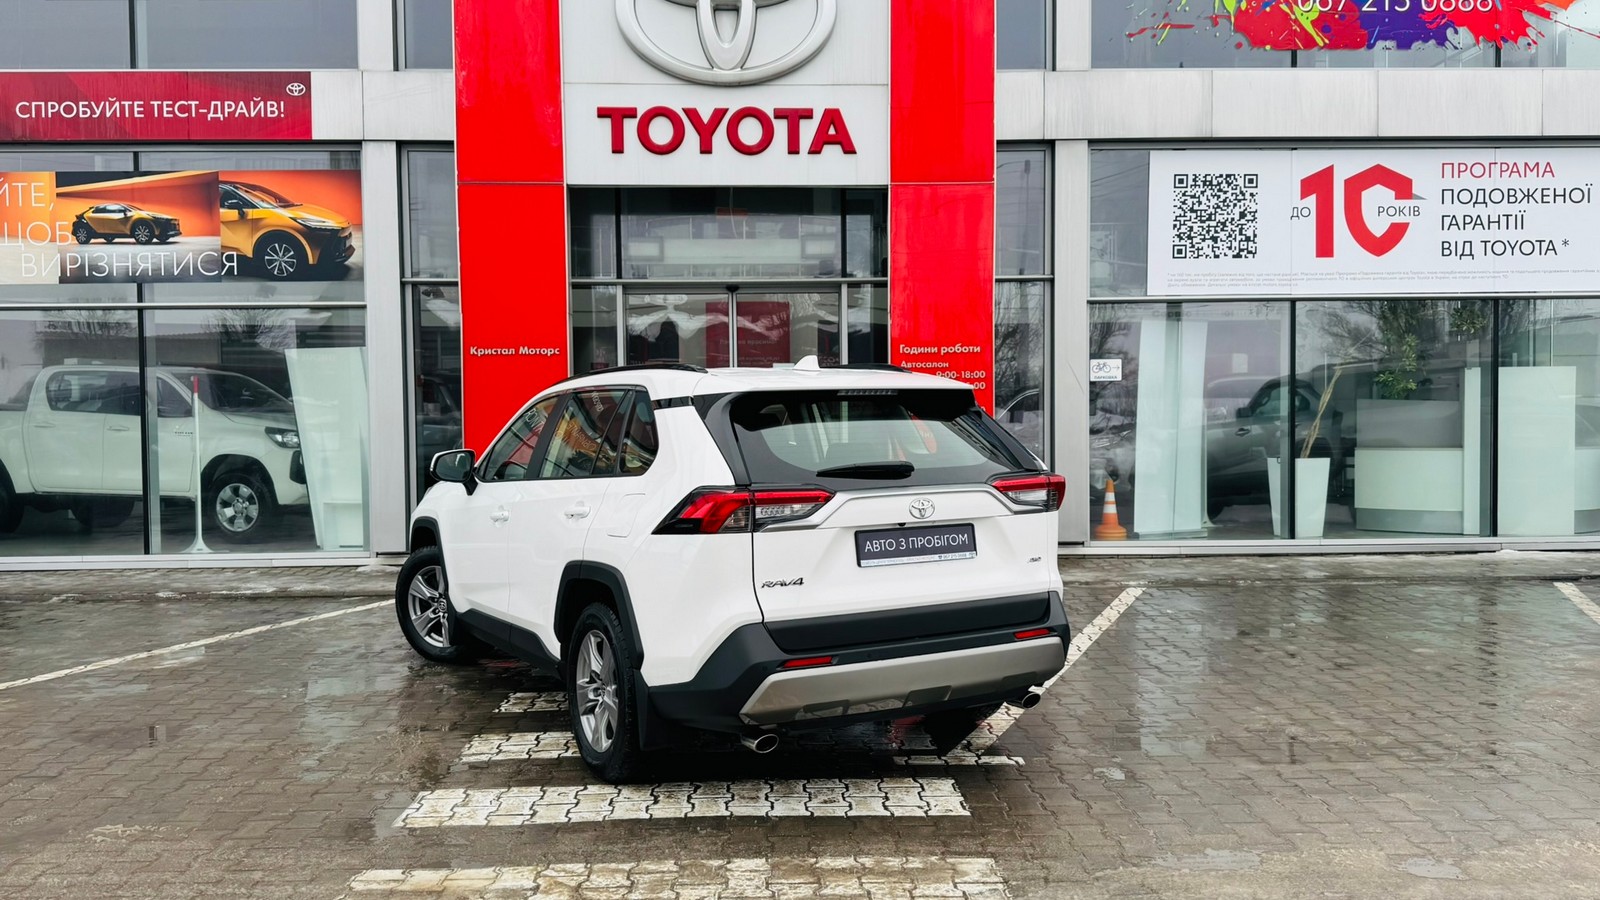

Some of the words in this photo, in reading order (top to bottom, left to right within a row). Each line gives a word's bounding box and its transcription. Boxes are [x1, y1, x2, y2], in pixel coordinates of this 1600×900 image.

[15, 97, 145, 119] СПРОБУЙТЕ
[150, 97, 286, 121] ТЕСТ-ДРАЙВ!
[597, 106, 857, 155] TOYOTA
[1441, 161, 1556, 179] ПРОГРАМА
[1441, 183, 1593, 208] ПОДОВЖЕНОЇ
[1290, 206, 1311, 221] ДО
[1377, 205, 1421, 217] РОКІВ
[1441, 210, 1527, 231] ГАРАНТІЇ
[1441, 240, 1475, 260] ВІД
[22, 251, 238, 277] ВИРІЗНЯТИСЯ
[470, 346, 515, 357] Кристал
[519, 346, 560, 357] Моторс
[899, 344, 938, 355] Години
[941, 343, 981, 355] роботи
[901, 360, 949, 368] Автосалон
[864, 538, 896, 553] АВТО
[908, 533, 969, 549] ПРОБІГОМ
[761, 577, 805, 588] RAV4
